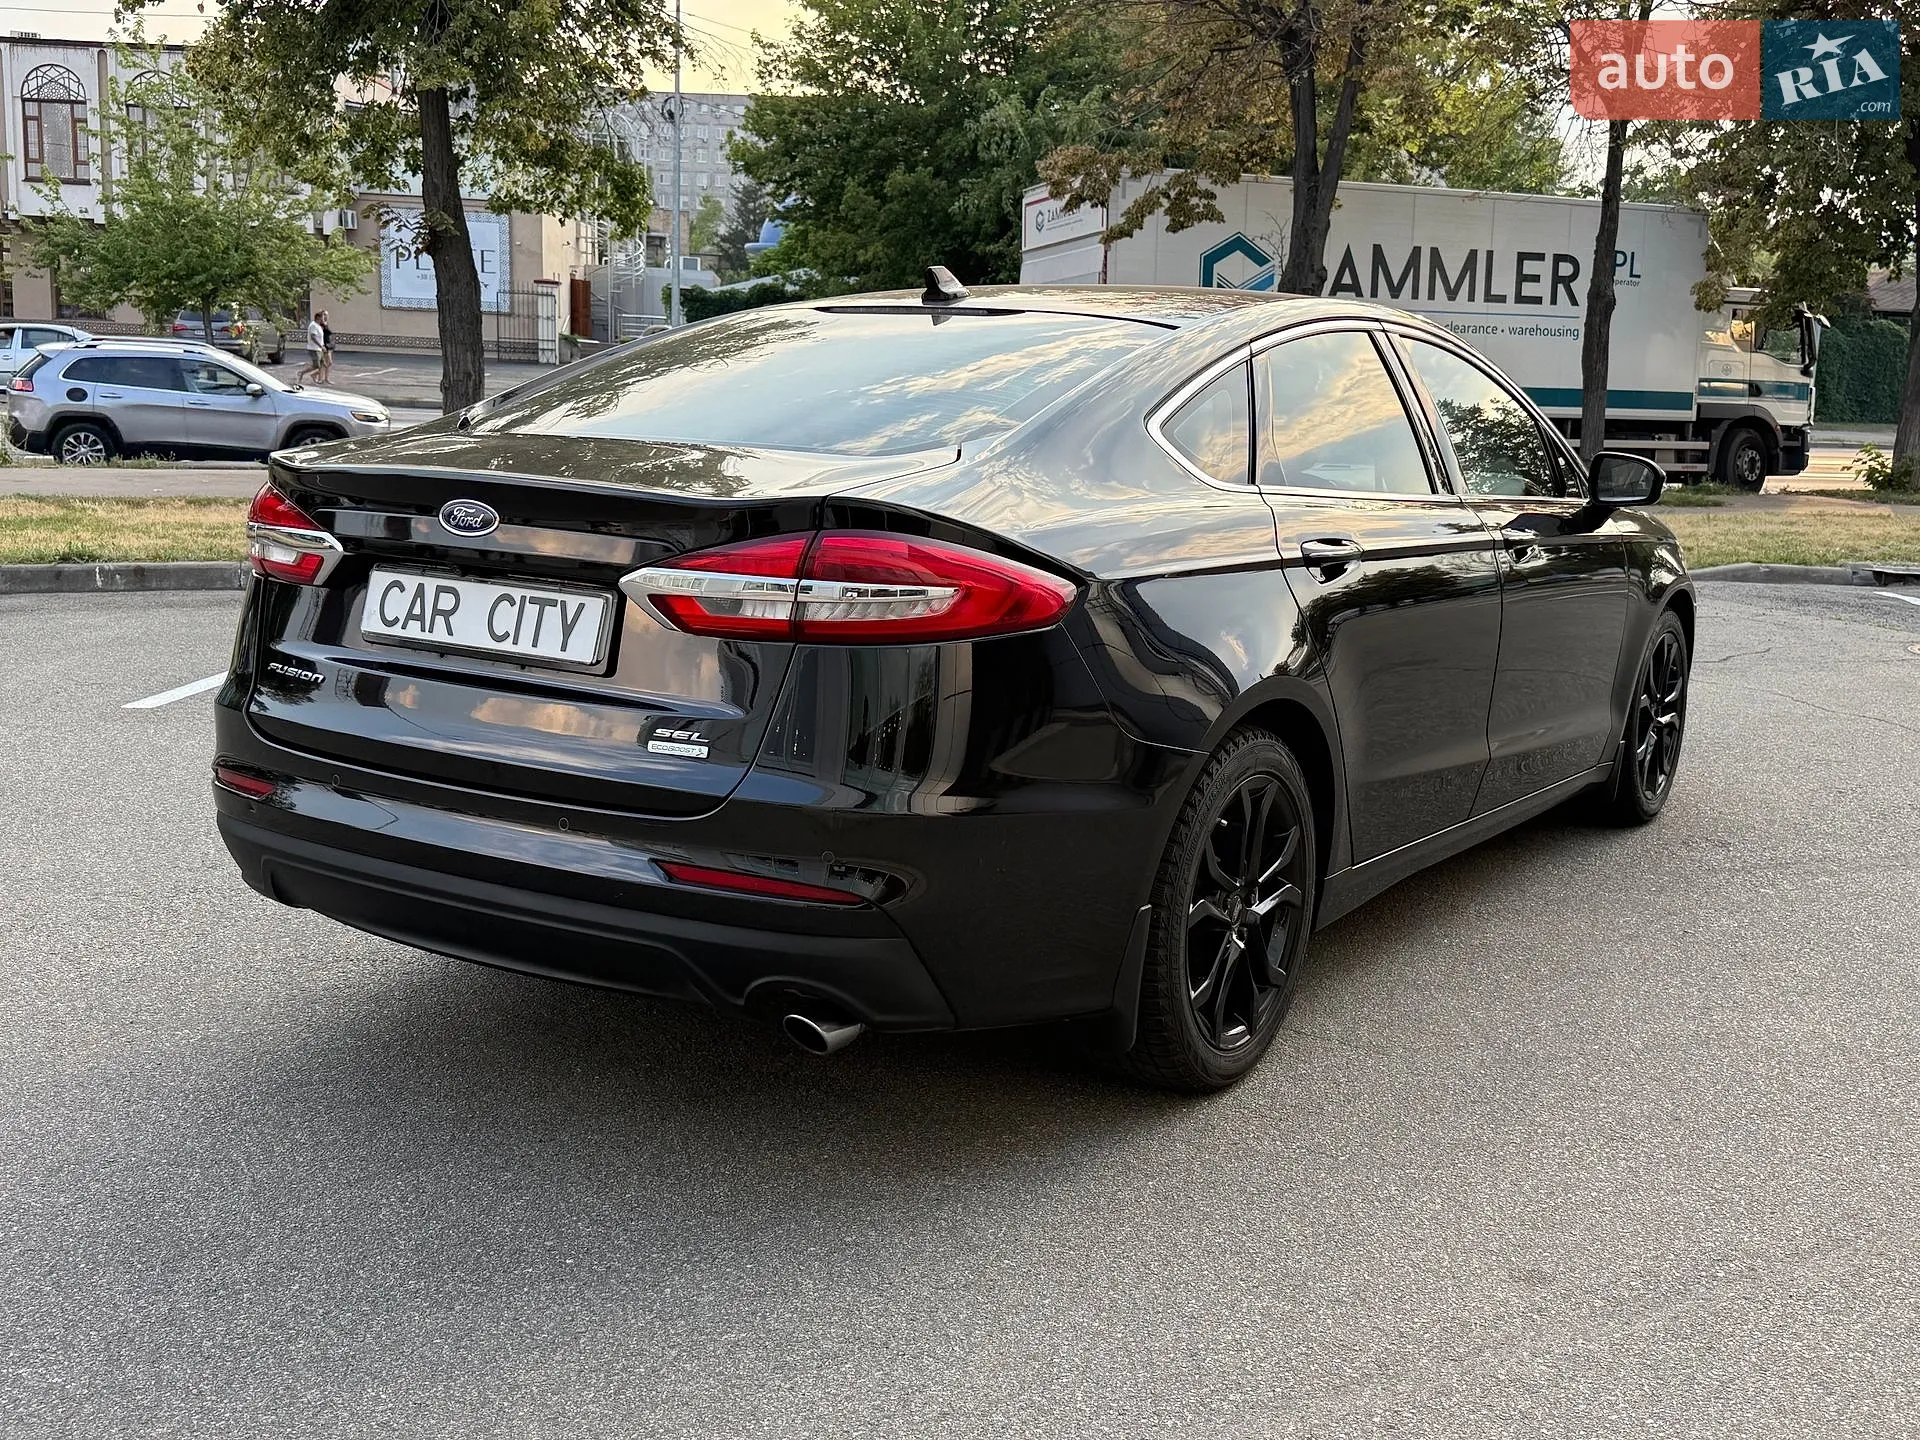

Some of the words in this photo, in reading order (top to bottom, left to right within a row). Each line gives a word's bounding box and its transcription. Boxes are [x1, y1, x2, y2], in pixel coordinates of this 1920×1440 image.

[395, 245, 497, 274] PLE
[1613, 250, 1641, 279] PL
[1328, 243, 1580, 307] AMMLER
[1614, 279, 1641, 288] perator
[1508, 324, 1580, 340] warehousing
[450, 506, 485, 528] Ford
[379, 579, 461, 636] CAR
[487, 592, 585, 652] CITY
[267, 662, 325, 683] FUSION
[652, 728, 710, 743] SEL
[651, 743, 697, 753] ECOBOOST
